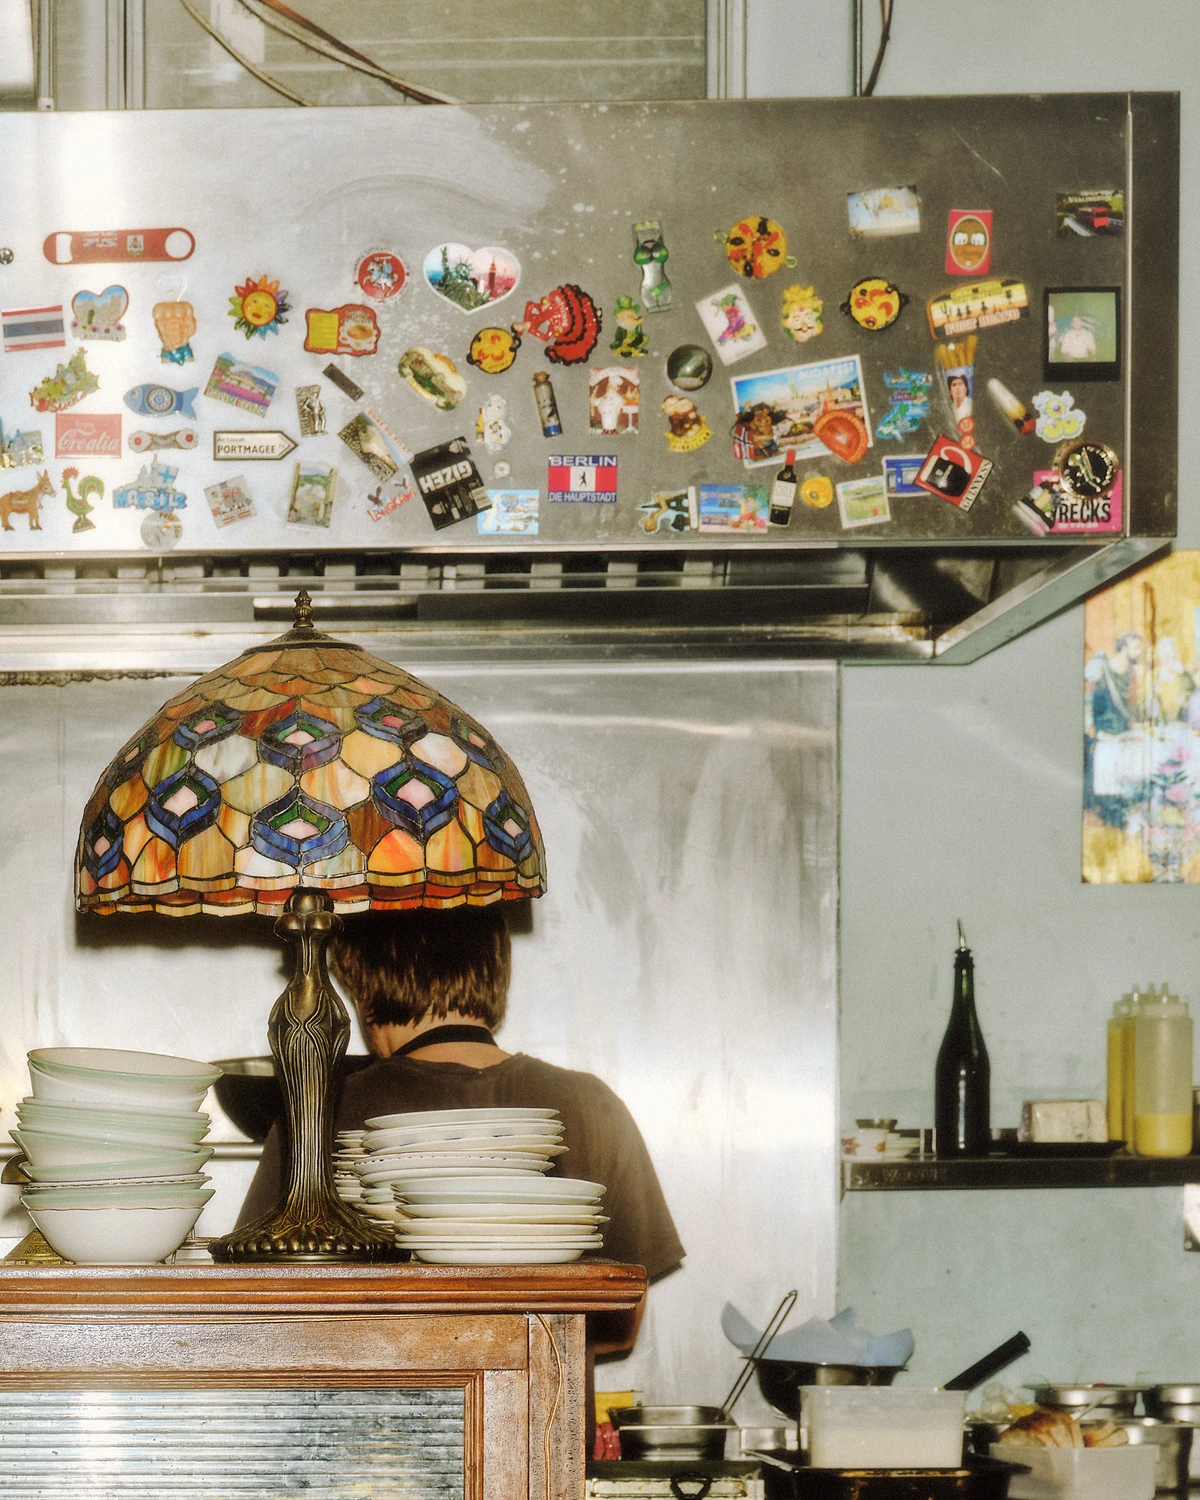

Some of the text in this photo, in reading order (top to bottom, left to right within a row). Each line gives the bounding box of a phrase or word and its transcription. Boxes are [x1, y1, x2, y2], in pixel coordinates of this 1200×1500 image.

[217, 445, 276, 454] PORTMAGEE
[549, 456, 617, 467] BERLIN
[419, 460, 473, 495] GIZEH
[962, 460, 992, 509] GUINNESS
[548, 492, 617, 502] DIE HAUPTSTADT
[1054, 503, 1111, 523] RECKS
